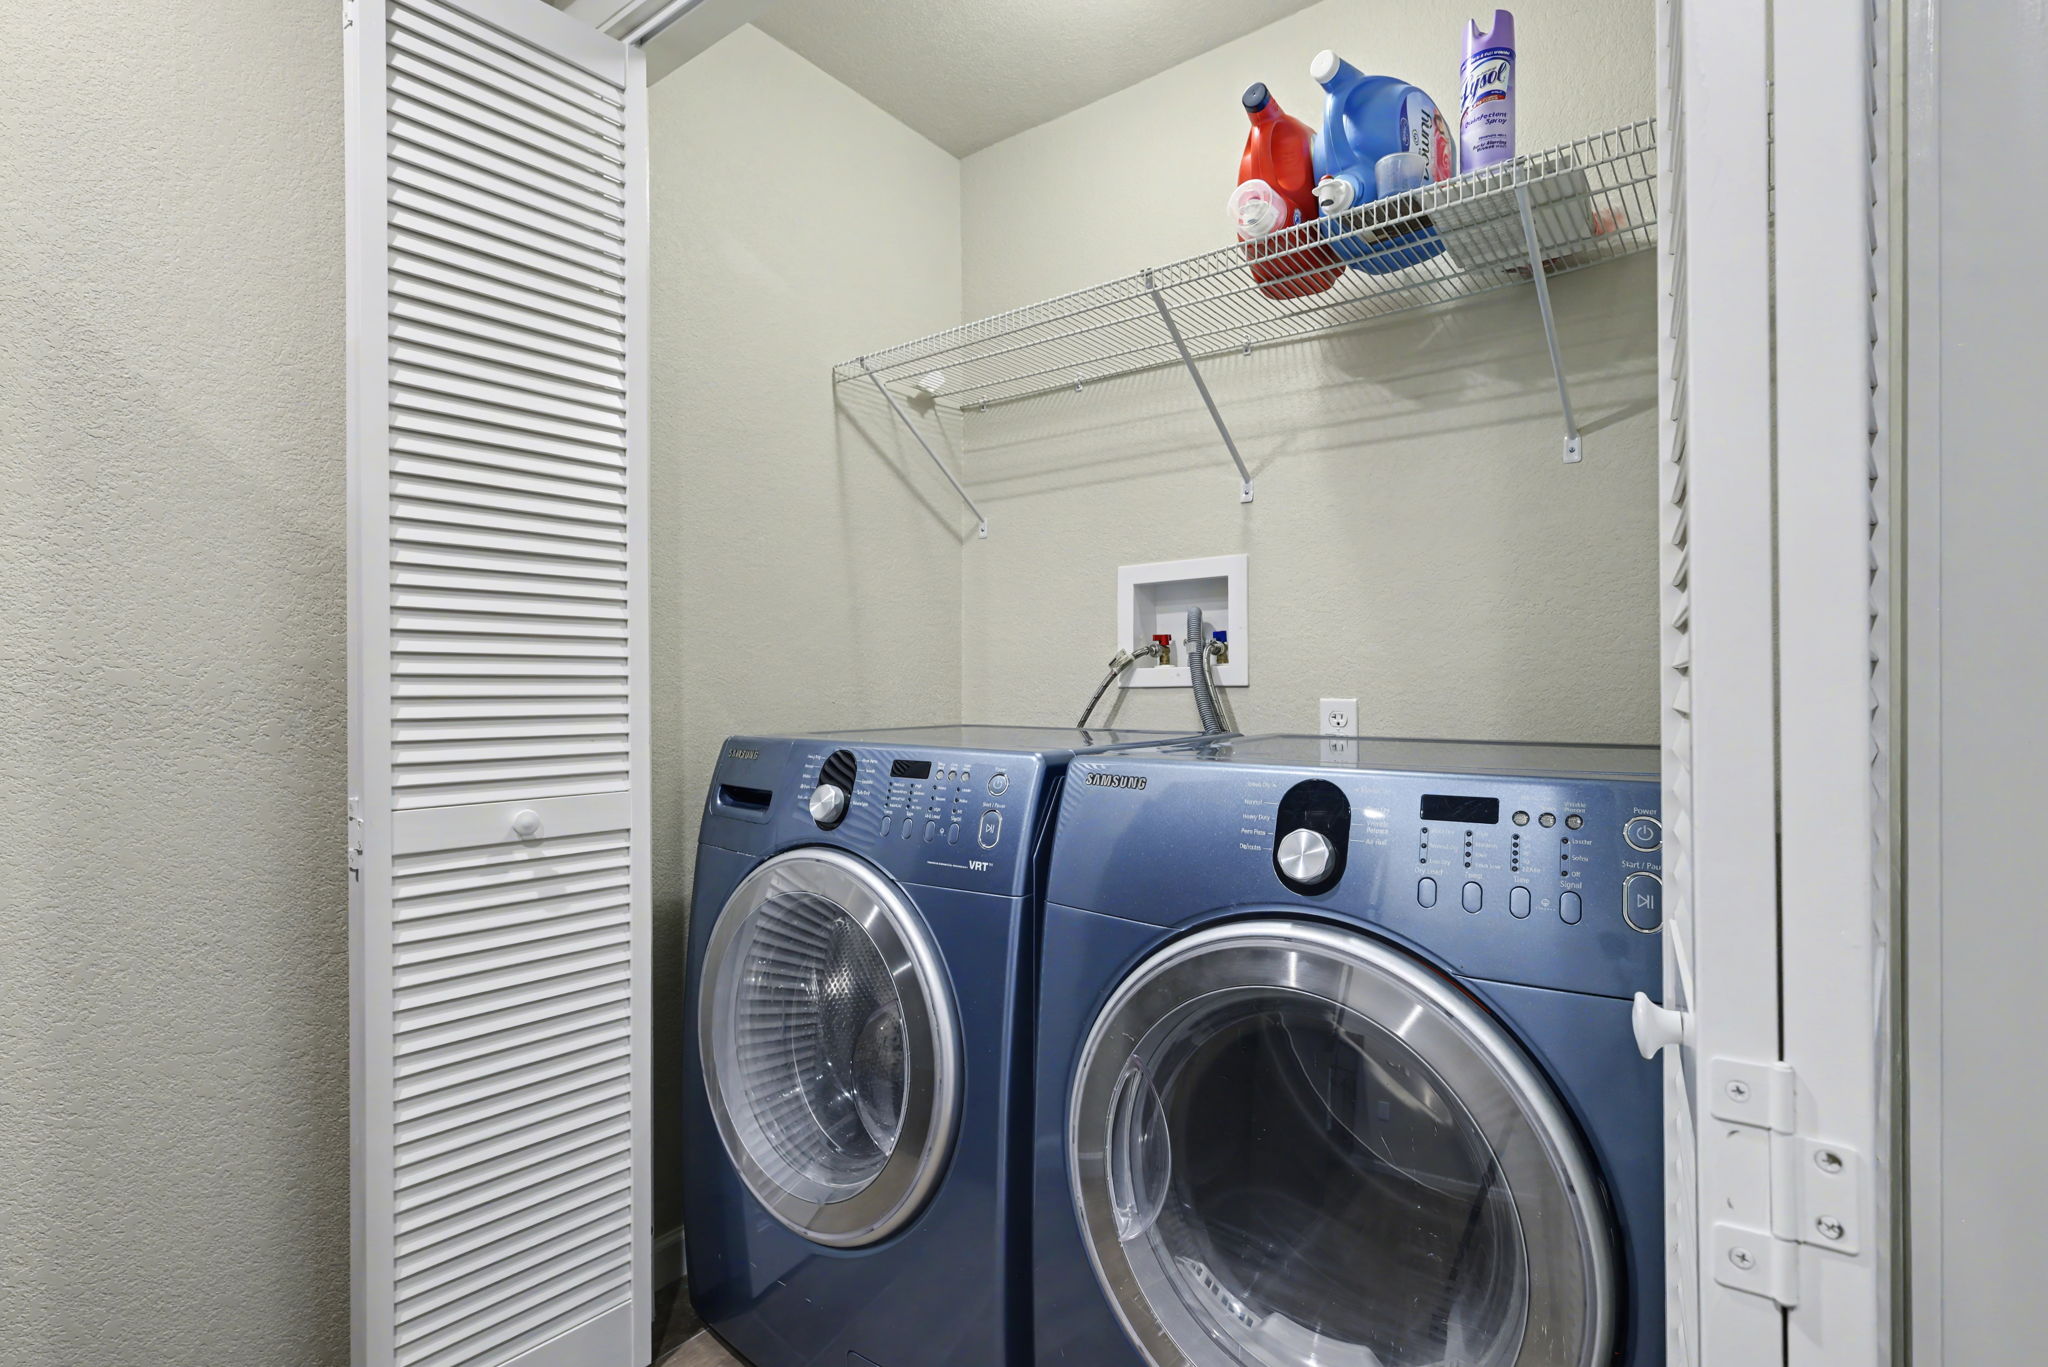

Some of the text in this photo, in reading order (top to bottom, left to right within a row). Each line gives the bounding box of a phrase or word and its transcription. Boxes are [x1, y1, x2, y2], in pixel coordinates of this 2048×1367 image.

[1460, 62, 1507, 113] Lysol
[1484, 117, 1507, 125] Spray
[1419, 108, 1433, 181] owny
[1085, 772, 1147, 790] SAMSUNG
[1633, 807, 1657, 815] Power
[1621, 859, 1640, 869] Start
[1646, 862, 1662, 871] Pau
[1560, 880, 1583, 892] Signal
